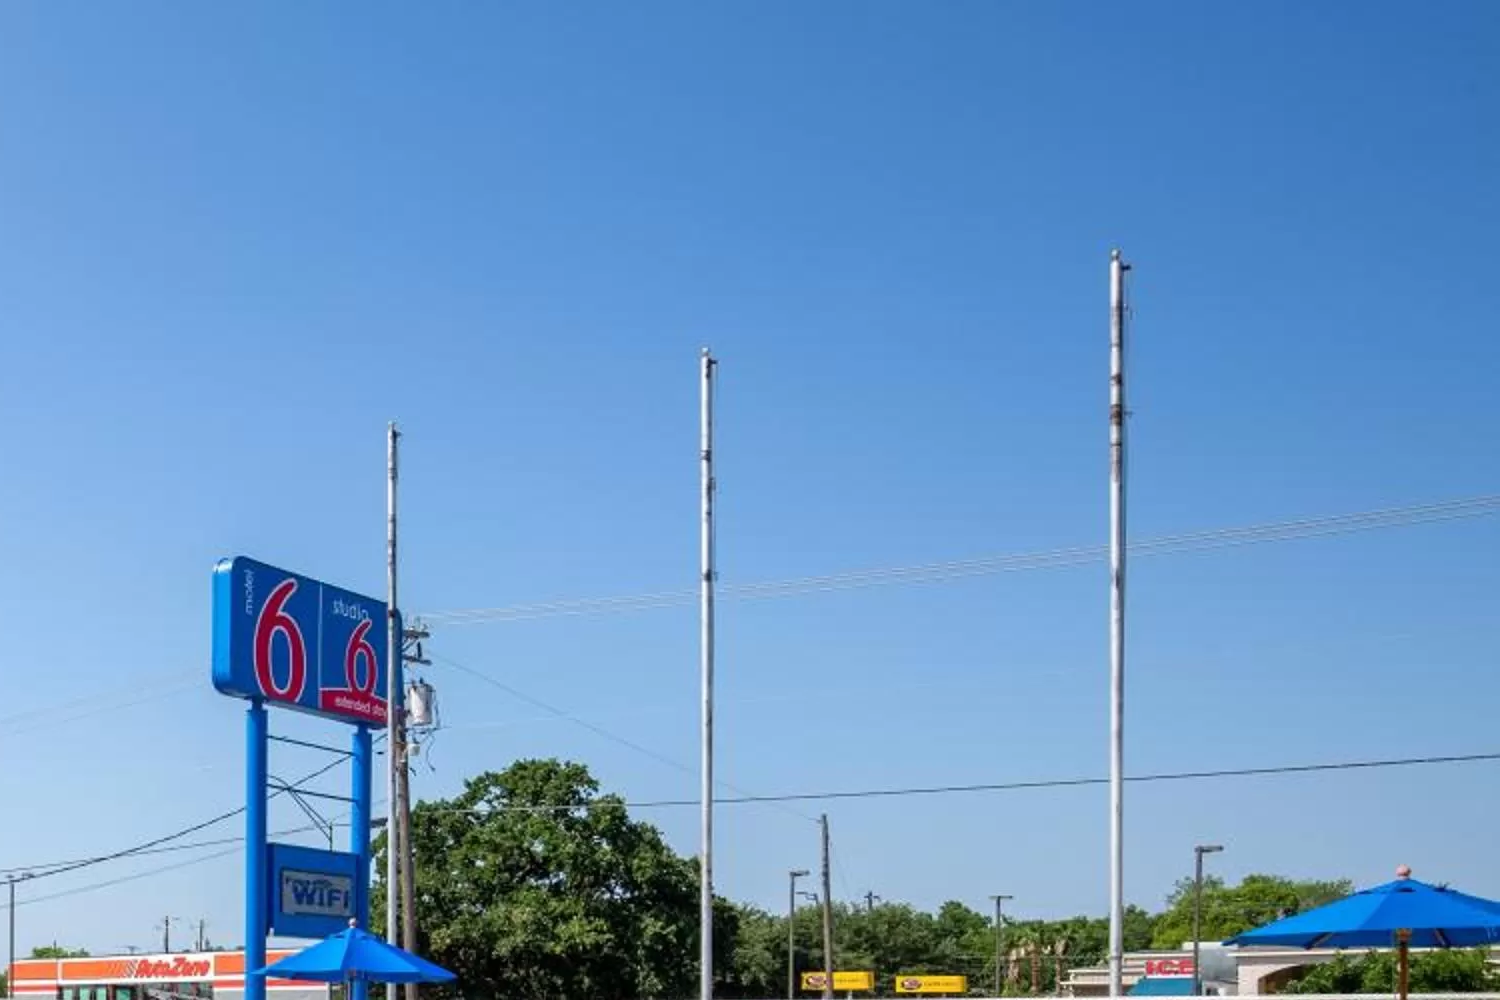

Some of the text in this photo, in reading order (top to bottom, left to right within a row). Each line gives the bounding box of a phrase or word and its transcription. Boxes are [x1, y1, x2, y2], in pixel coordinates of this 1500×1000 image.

[244, 569, 255, 615] motel
[333, 598, 369, 622] studio
[254, 578, 306, 702] 6
[345, 619, 379, 701] 6
[334, 696, 371, 713] extended
[135, 956, 210, 979] AutoZone
[1146, 960, 1194, 977] ICE
